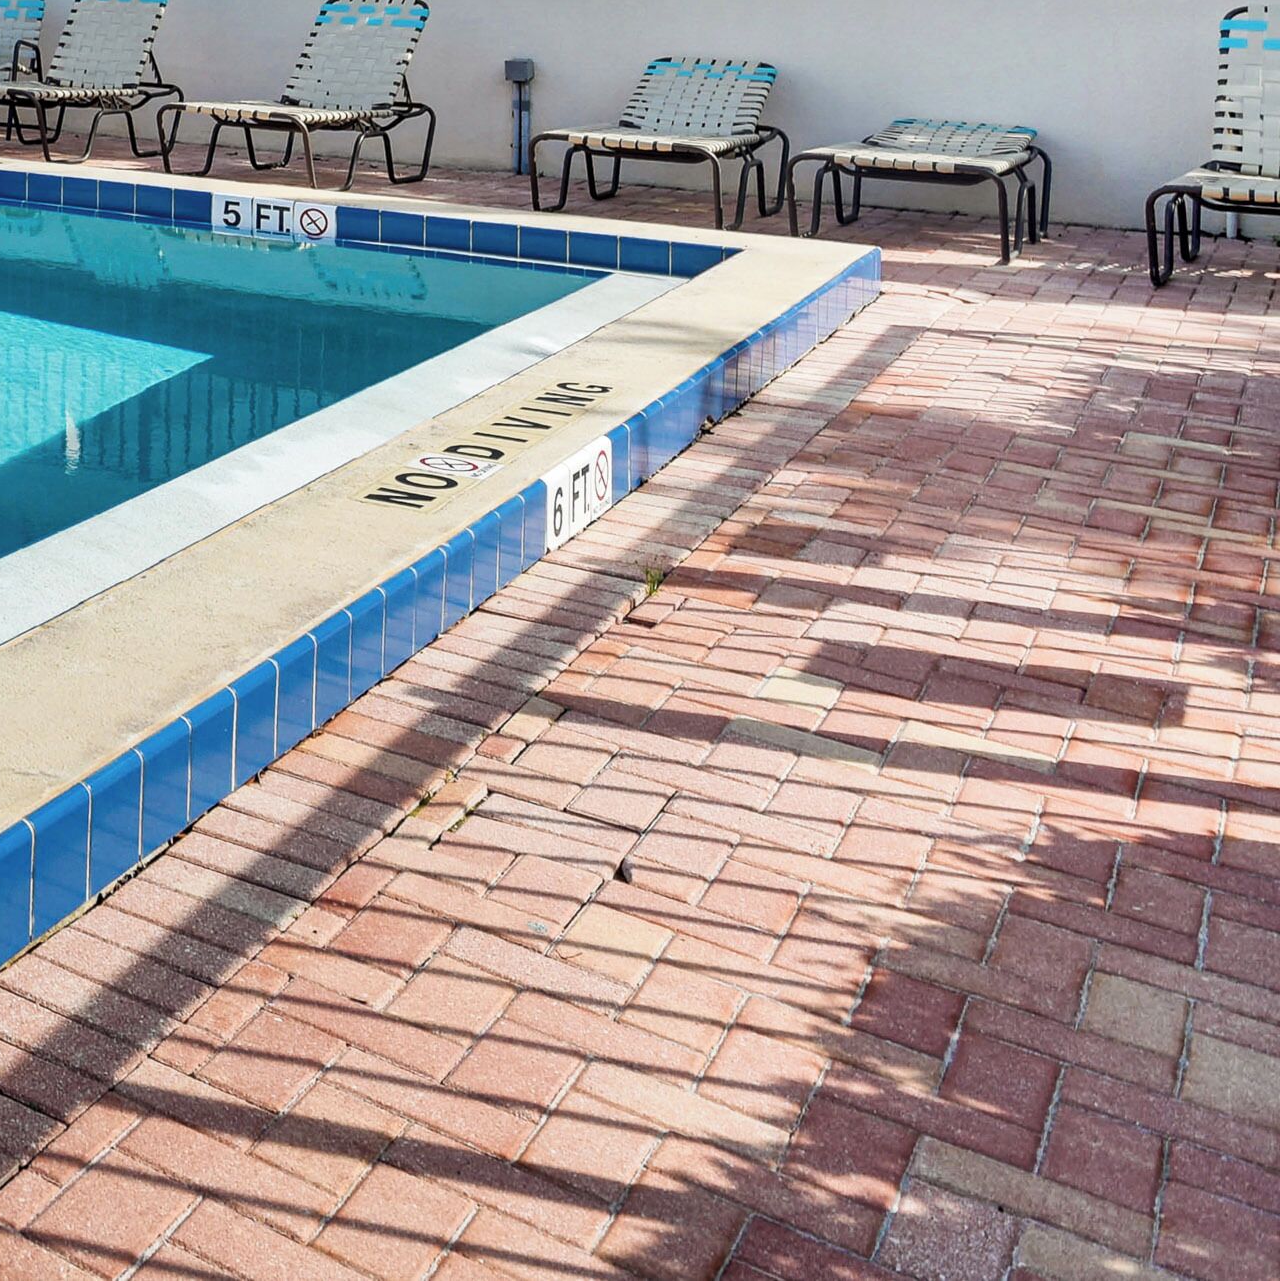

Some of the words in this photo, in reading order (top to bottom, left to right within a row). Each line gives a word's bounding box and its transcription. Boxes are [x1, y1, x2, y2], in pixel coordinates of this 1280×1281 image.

[223, 201, 241, 227] 5
[363, 472, 458, 509] NO
[442, 381, 614, 460] DIVING
[553, 486, 563, 537] 6
